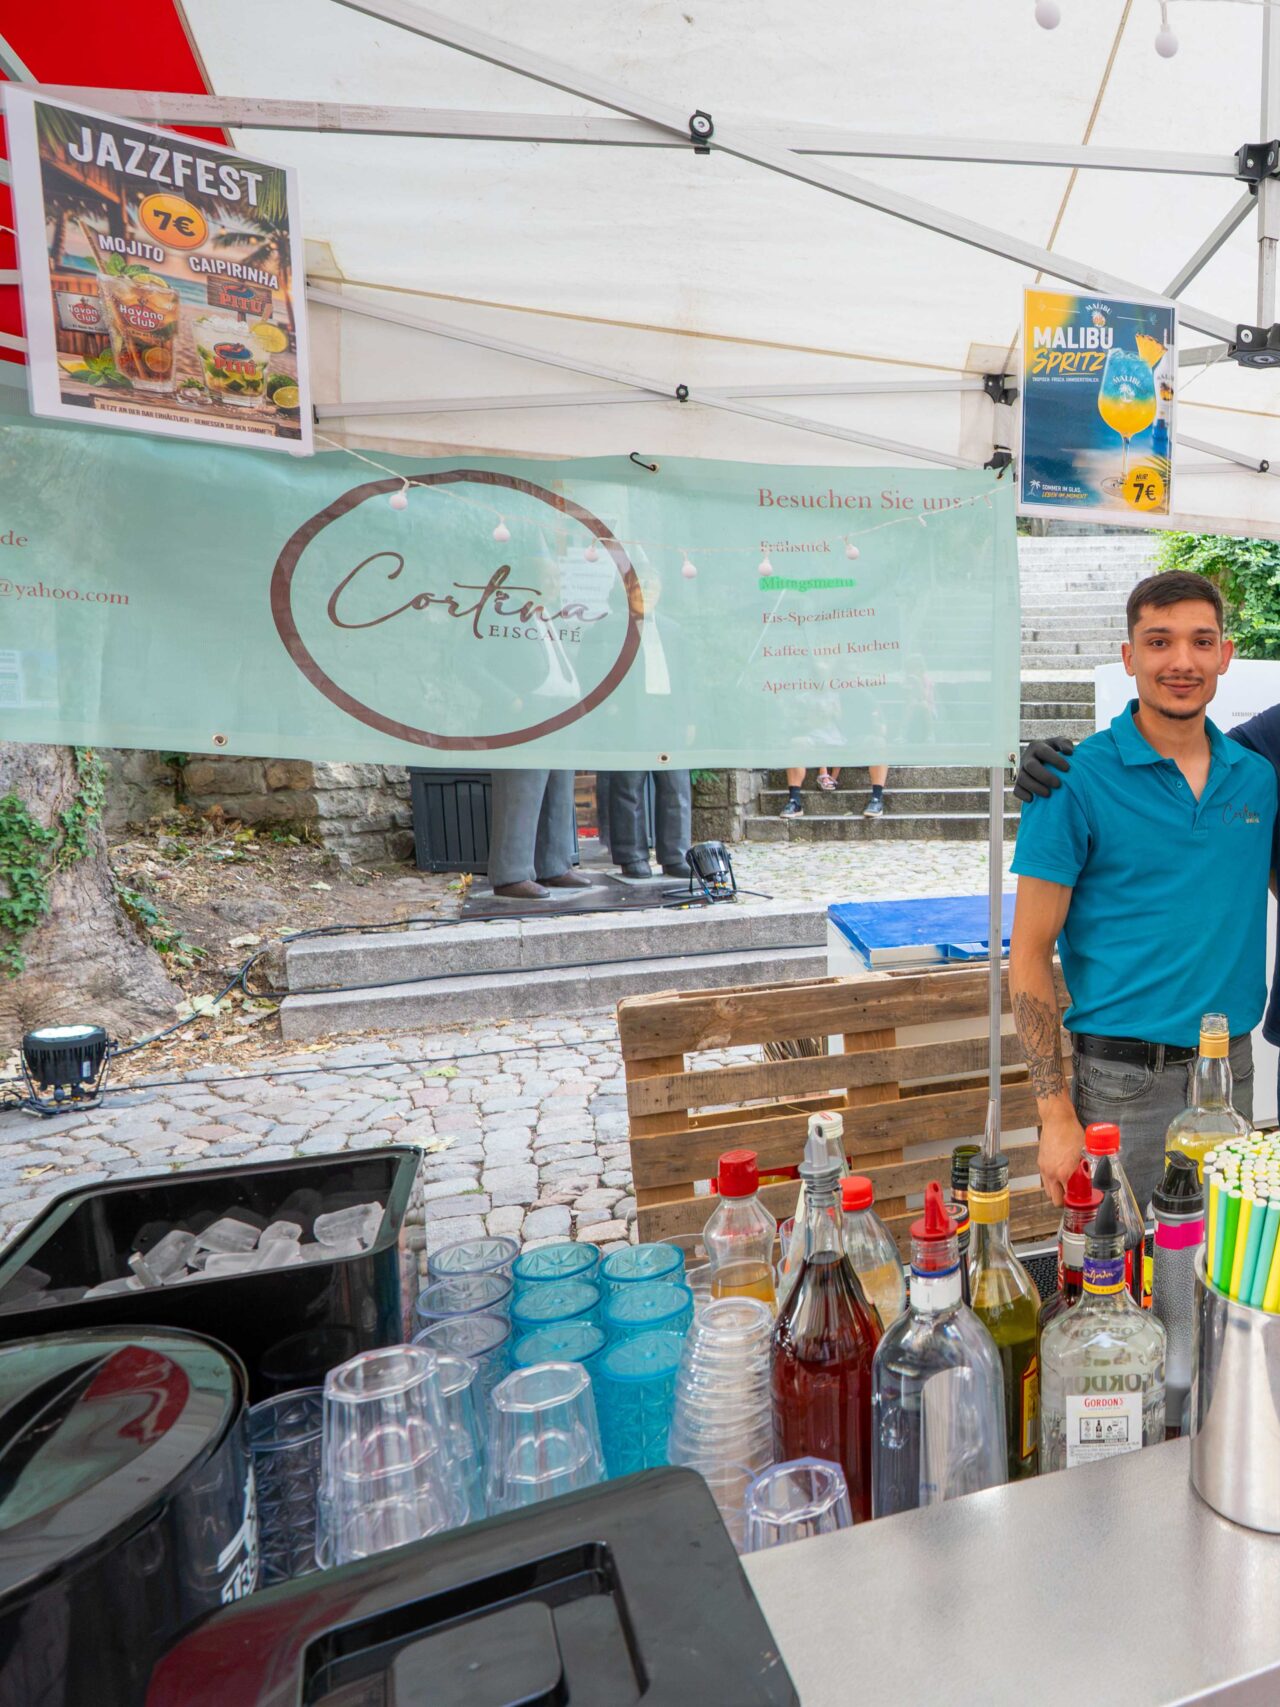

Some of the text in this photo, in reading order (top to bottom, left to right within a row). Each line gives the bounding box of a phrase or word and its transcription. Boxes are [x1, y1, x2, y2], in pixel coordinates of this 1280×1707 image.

[68, 126, 263, 207] JAZZFEST
[152, 208, 196, 238] 7€
[99, 234, 164, 263] MOJITO
[189, 257, 279, 290] CAIPIRINHA
[67, 304, 100, 317] Havan
[120, 304, 164, 320] Havana
[1085, 302, 1112, 315] MALIBU
[129, 315, 156, 328] Club
[1033, 326, 1114, 350] MALIBU
[1032, 348, 1106, 375] SPRITZ
[757, 488, 873, 510] Besuchen
[880, 490, 914, 511] Sie
[1132, 483, 1156, 503] 7€
[327, 551, 609, 640] Cortina
[761, 606, 876, 626] Eis-Spezialitäten
[488, 624, 582, 643] EISCAFÉ
[762, 639, 900, 657] Kaffee und Kuchen
[829, 673, 887, 690] Cocktail
